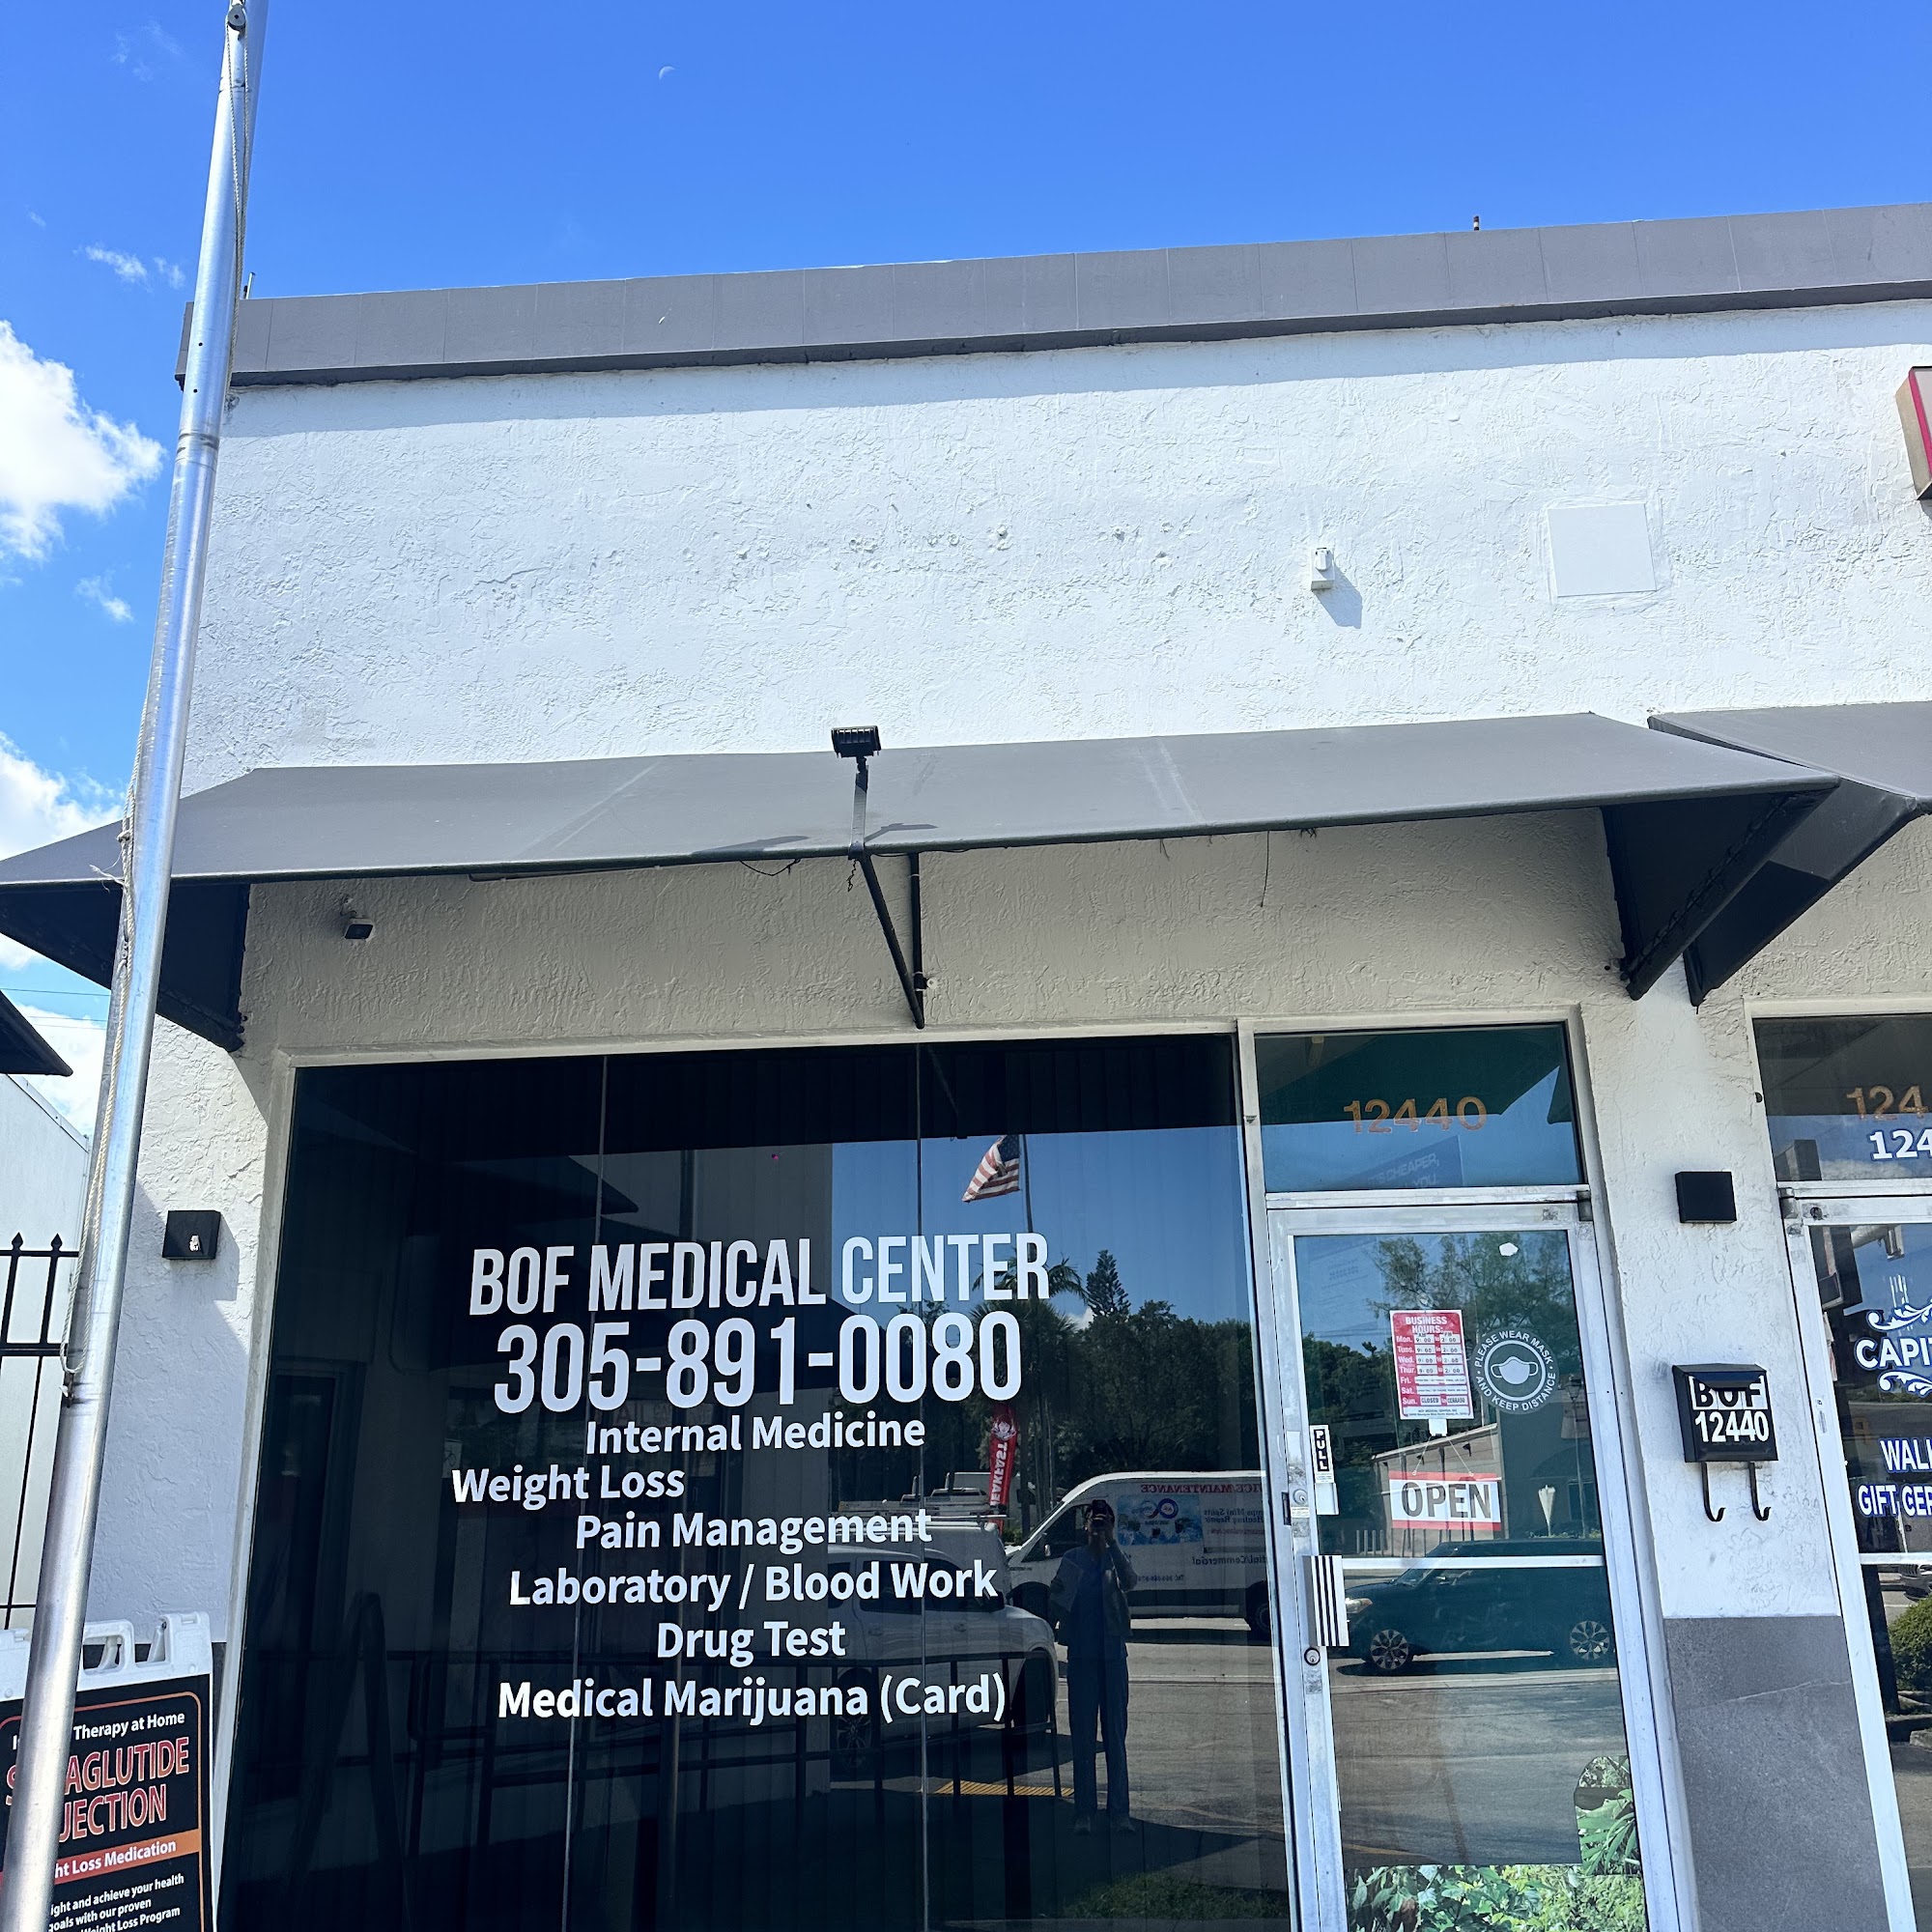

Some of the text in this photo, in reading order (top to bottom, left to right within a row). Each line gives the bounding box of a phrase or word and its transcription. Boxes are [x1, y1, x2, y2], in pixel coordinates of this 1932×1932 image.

[1343, 1095, 1488, 1133] 12440
[1846, 1085, 1929, 1120] 124
[1869, 1129, 1932, 1159] 124
[469, 1233, 1050, 1316] BOF MEDICAL CENTER
[494, 1311, 1022, 1414] 305-891-0080
[1474, 1330, 1554, 1367] PLEASE WEAR MASK
[1856, 1337, 1932, 1369] CAPI
[1476, 1372, 1556, 1411] AND KEEP DISTANCE
[586, 1418, 741, 1455] Internal
[753, 1411, 924, 1450] Medicine
[1694, 1410, 1769, 1443] 12440
[1315, 1430, 1328, 1470] PULL
[451, 1463, 685, 1510] Weight Loss
[1401, 1481, 1492, 1520] OPEN
[1858, 1485, 1896, 1516] GIFT
[576, 1508, 933, 1555] Pain Management
[509, 1559, 999, 1612] Laboratory / Blood Work
[657, 1621, 846, 1668] Drug Test
[498, 1672, 1006, 1726] Medical Marijuana (Card)
[73, 1713, 185, 1741] Therapy at Home
[7, 1736, 189, 1796] AGLUTIDE
[6, 1783, 167, 1843] JECTION
[72, 1857, 101, 1875] Loss
[104, 1839, 177, 1867] Medication
[50, 1873, 185, 1918] ight and achieve your health
[75, 1910, 99, 1926] with
[99, 1907, 116, 1920] our
[117, 1898, 152, 1918] proven
[116, 1916, 139, 1931] Loss
[139, 1906, 181, 1925] Program
